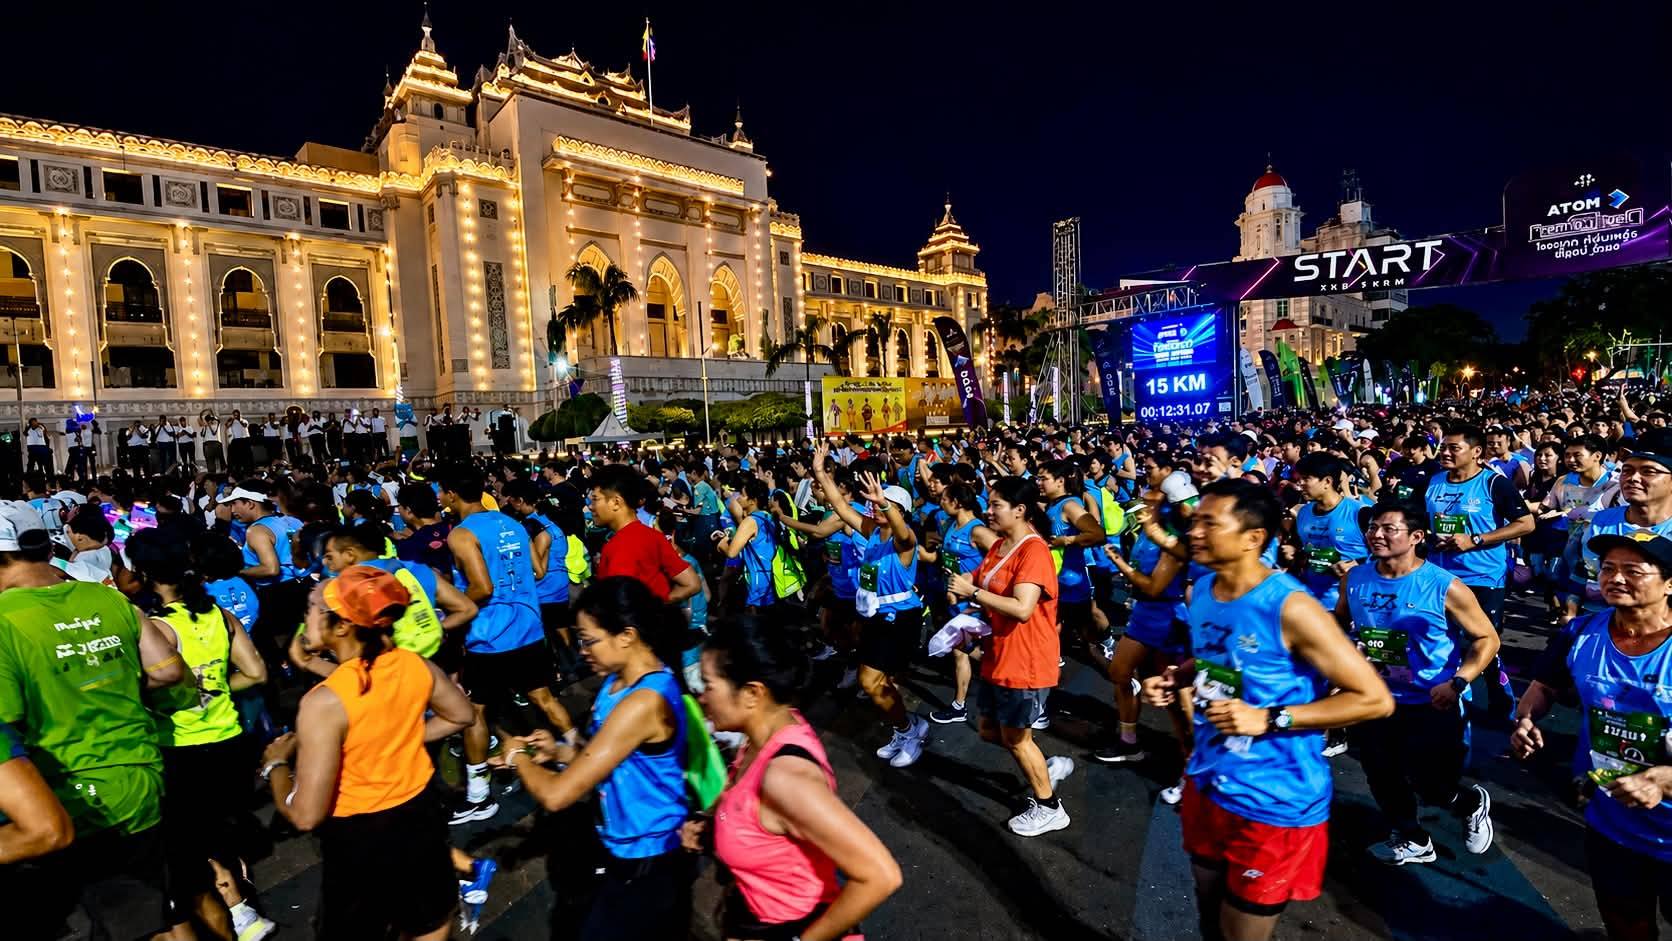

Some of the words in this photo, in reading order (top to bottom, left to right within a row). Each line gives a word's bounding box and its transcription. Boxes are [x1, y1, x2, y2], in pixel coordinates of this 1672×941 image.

[1547, 197, 1601, 216] ATOM
[1293, 239, 1443, 283] START
[1146, 378, 1169, 396] 15
[1173, 373, 1206, 393] KM
[1141, 402, 1211, 418] 00:12:31.07
